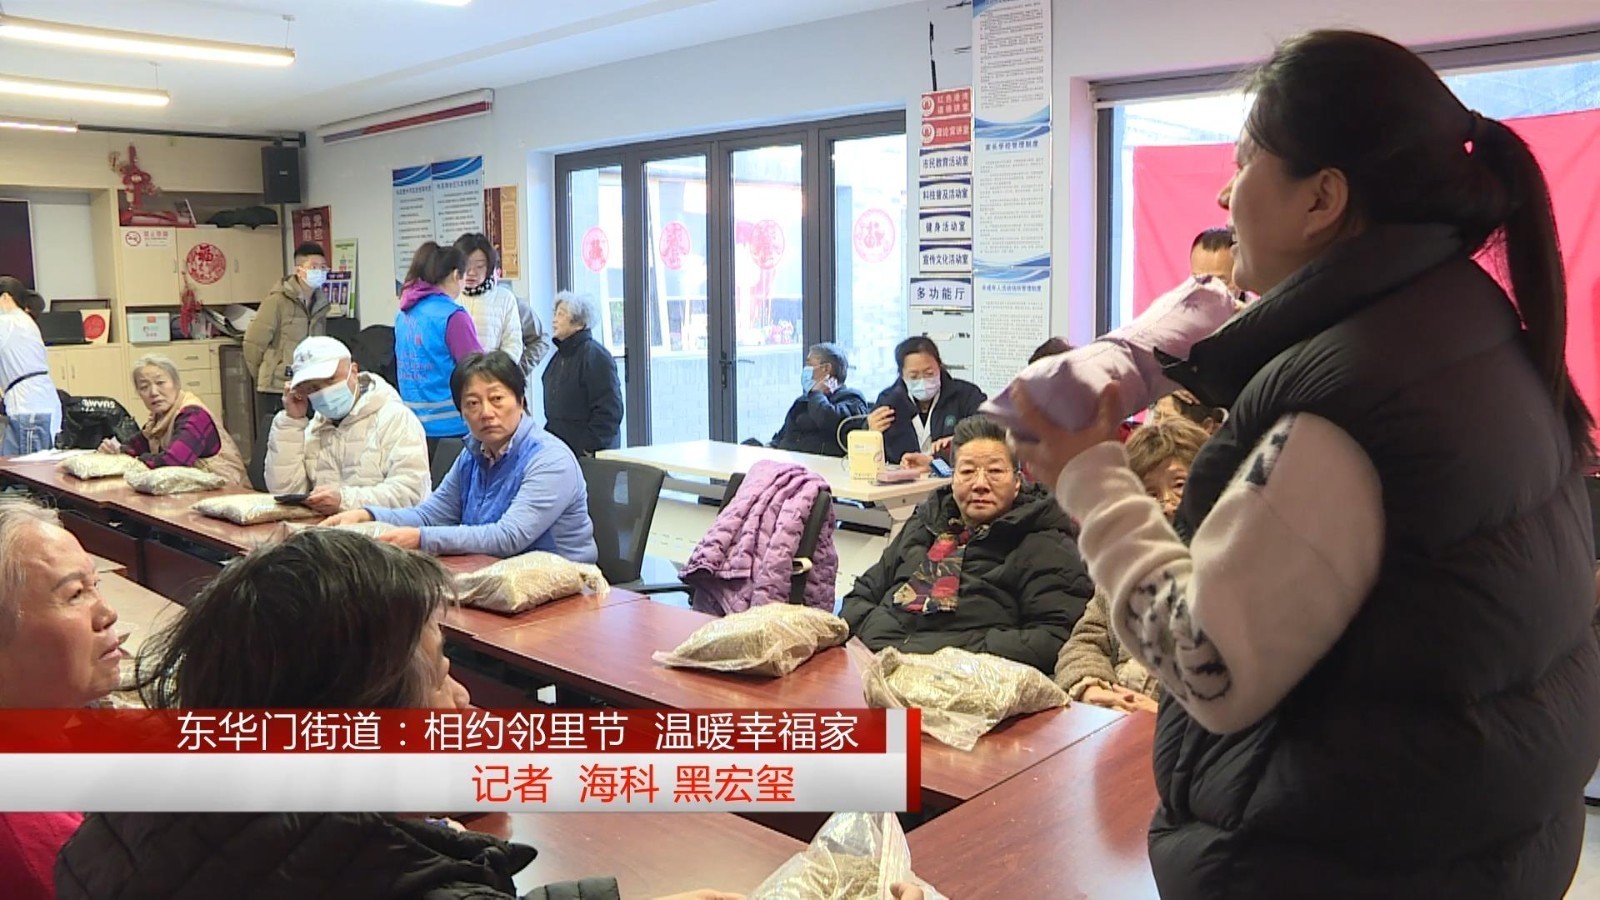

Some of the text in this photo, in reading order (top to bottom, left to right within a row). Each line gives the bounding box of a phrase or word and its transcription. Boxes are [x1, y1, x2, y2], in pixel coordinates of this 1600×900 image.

[922, 155, 969, 169] 市民教育活动室
[922, 187, 969, 201] 科技普及活动室
[926, 220, 967, 233] 健身活动室
[922, 252, 969, 267] 宣传文化活动室
[917, 285, 966, 301] 多功能厅
